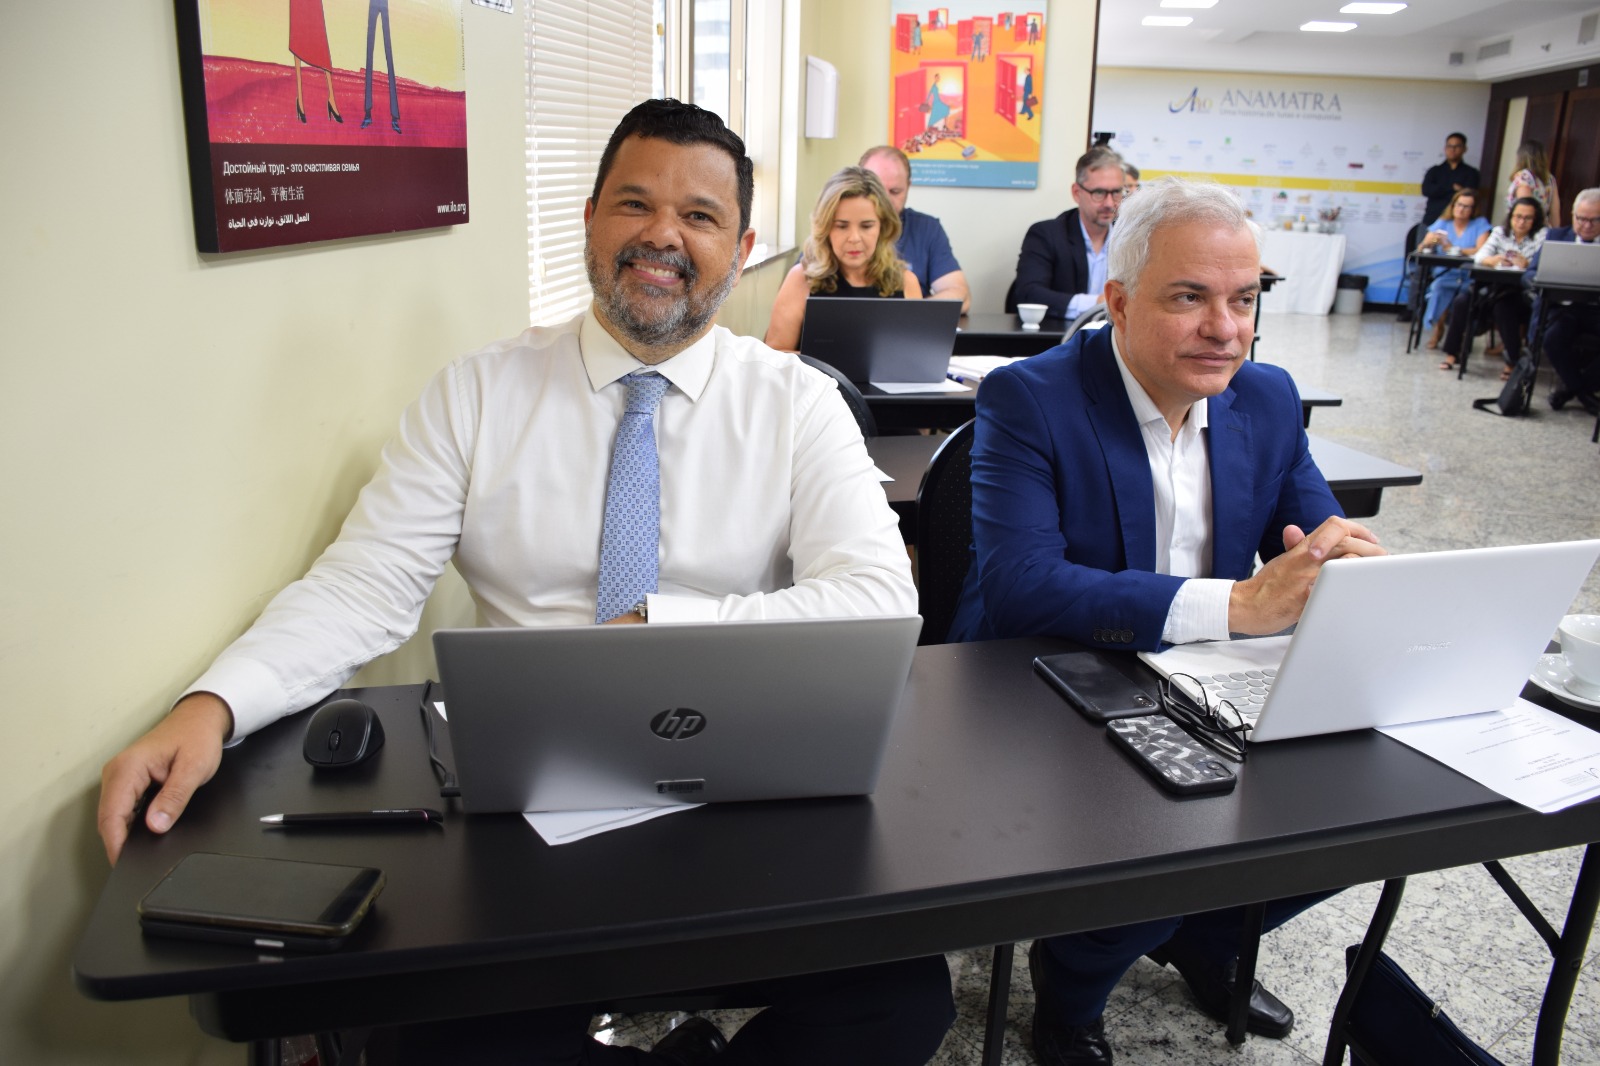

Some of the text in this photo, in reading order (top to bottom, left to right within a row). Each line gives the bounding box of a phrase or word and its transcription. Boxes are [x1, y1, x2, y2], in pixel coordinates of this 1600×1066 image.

[1220, 89, 1342, 112] ANAMATRA
[223, 161, 267, 176] Достойный
[268, 163, 286, 175] труд
[290, 163, 303, 173] это
[303, 163, 341, 173] счастливая
[341, 163, 360, 172] семья
[437, 200, 467, 215] www.ilo.org
[228, 217, 246, 230] الحياة
[294, 213, 310, 225] العمل
[656, 708, 702, 741] hp
